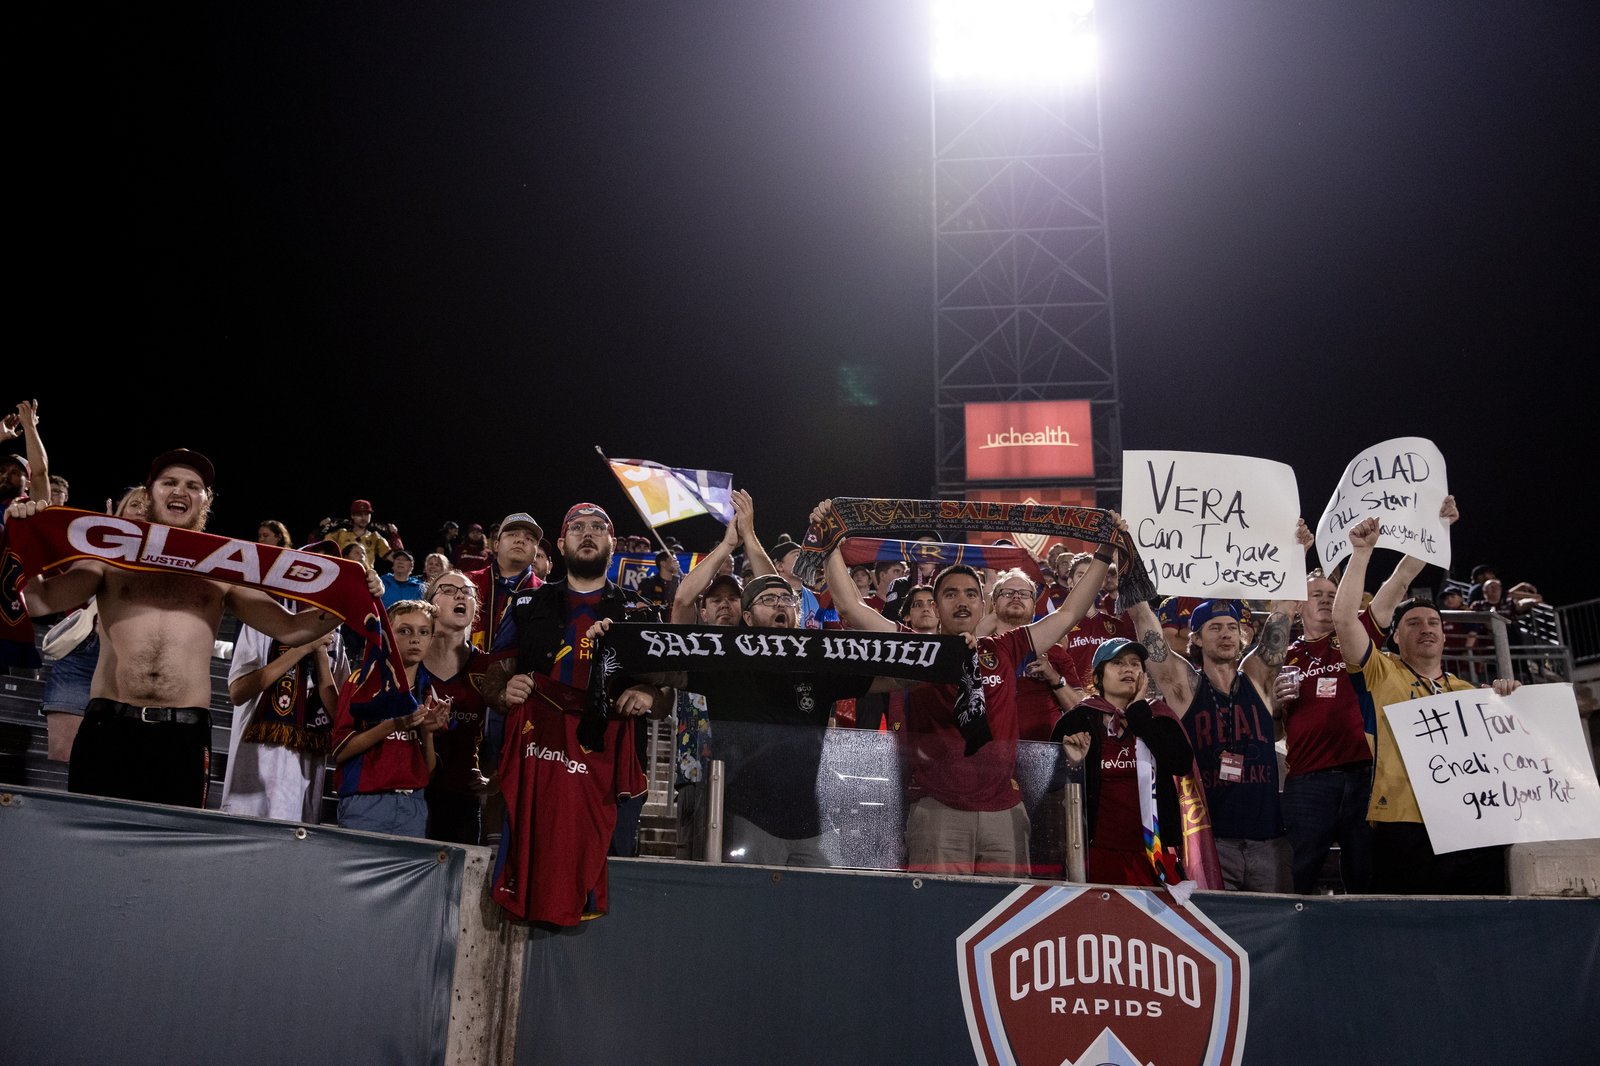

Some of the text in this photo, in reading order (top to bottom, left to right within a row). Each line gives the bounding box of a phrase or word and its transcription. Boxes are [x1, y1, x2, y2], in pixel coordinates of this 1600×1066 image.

[987, 425, 1070, 447] uchealth
[1352, 452, 1430, 487] GLAD
[1147, 460, 1249, 529] VERA
[1361, 490, 1418, 512] Star!
[939, 501, 1013, 521] SALT
[1023, 504, 1104, 532] LAKE
[67, 516, 341, 594] GLAD
[1138, 518, 1280, 566] Can I have
[1325, 540, 1347, 563] Can
[1379, 524, 1400, 539] ave
[141, 554, 197, 569] JUSTEN
[288, 564, 318, 580] 15
[640, 630, 942, 668] SALT CITY UNITED
[981, 674, 1004, 687] age.
[1299, 661, 1347, 681] eVantage
[386, 729, 418, 742] evan
[1194, 703, 1268, 752] REAL
[1475, 702, 1531, 742] Fan
[1101, 756, 1136, 769] feVant
[1540, 757, 1556, 774] I
[1462, 789, 1500, 820] get
[1009, 933, 1201, 1009] COLORADO
[1050, 996, 1163, 1018] RAPIDS
